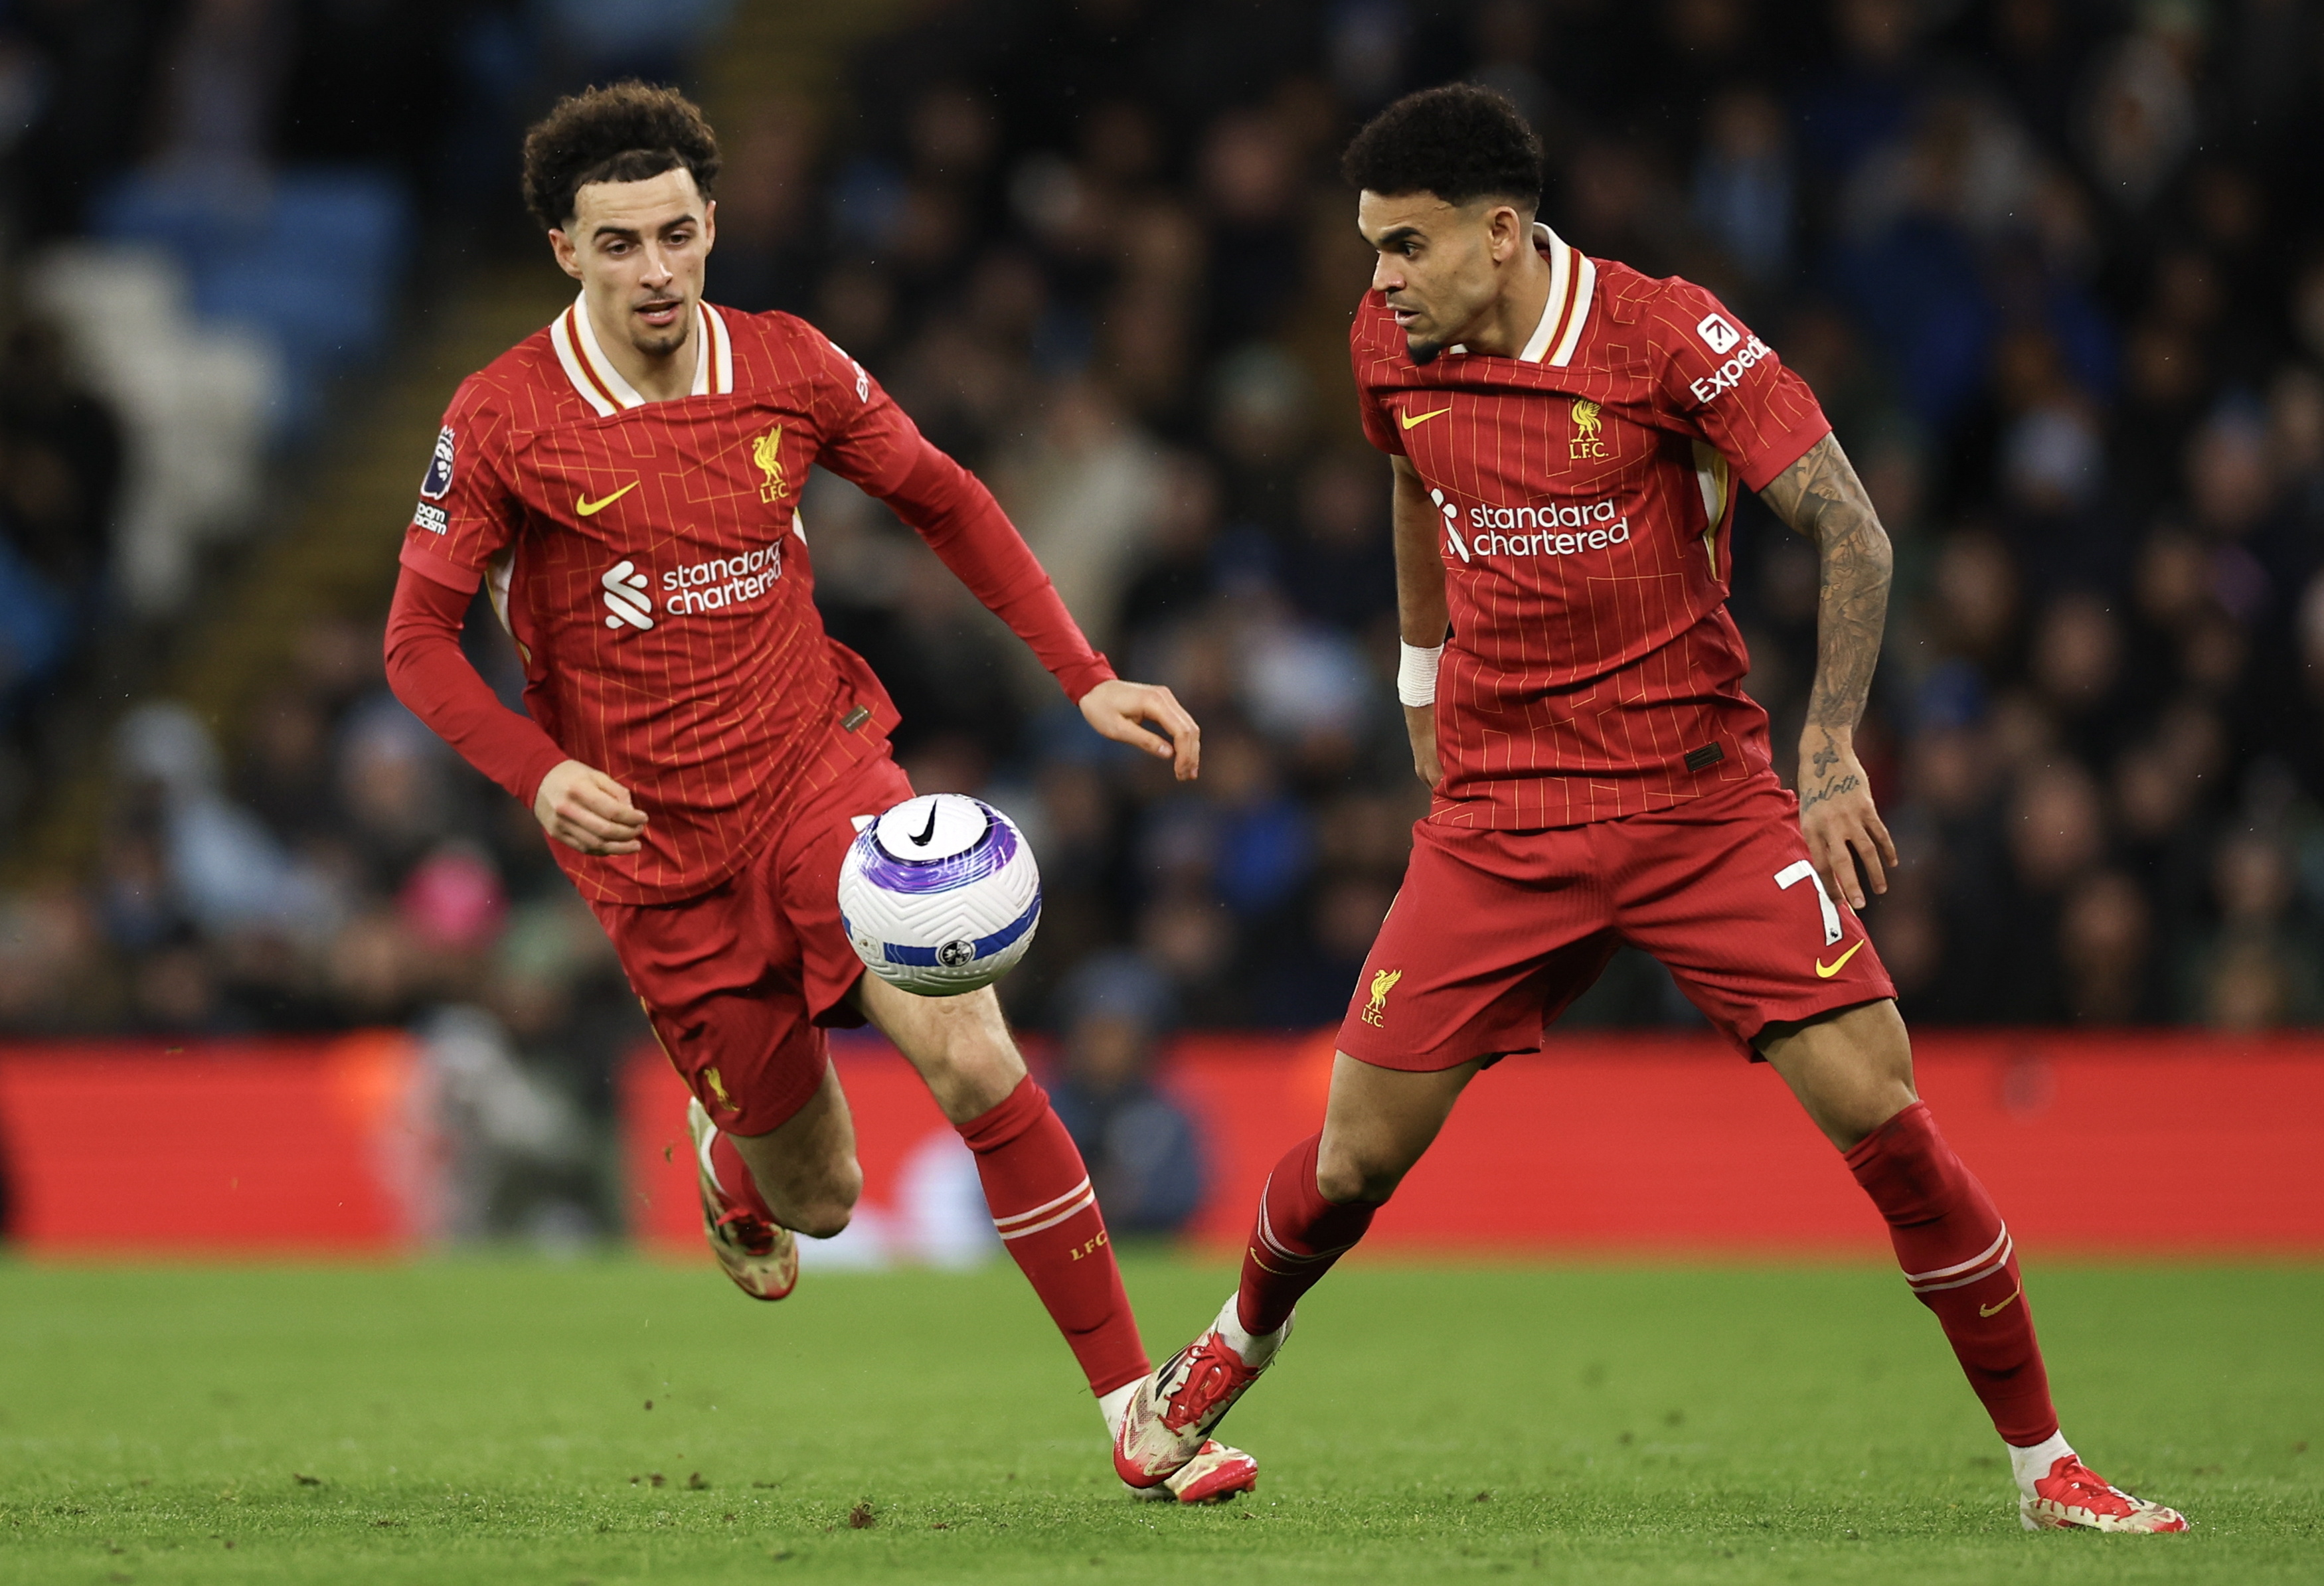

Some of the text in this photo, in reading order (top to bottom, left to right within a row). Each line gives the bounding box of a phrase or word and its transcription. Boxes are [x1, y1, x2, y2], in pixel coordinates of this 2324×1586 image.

[414, 514, 447, 536] acism
[417, 501, 446, 523] oom
[1470, 499, 1616, 529] standard
[1473, 516, 1629, 556] chartered
[663, 538, 783, 591] standard
[667, 552, 782, 615] chartered
[1774, 860, 1843, 946] 7
